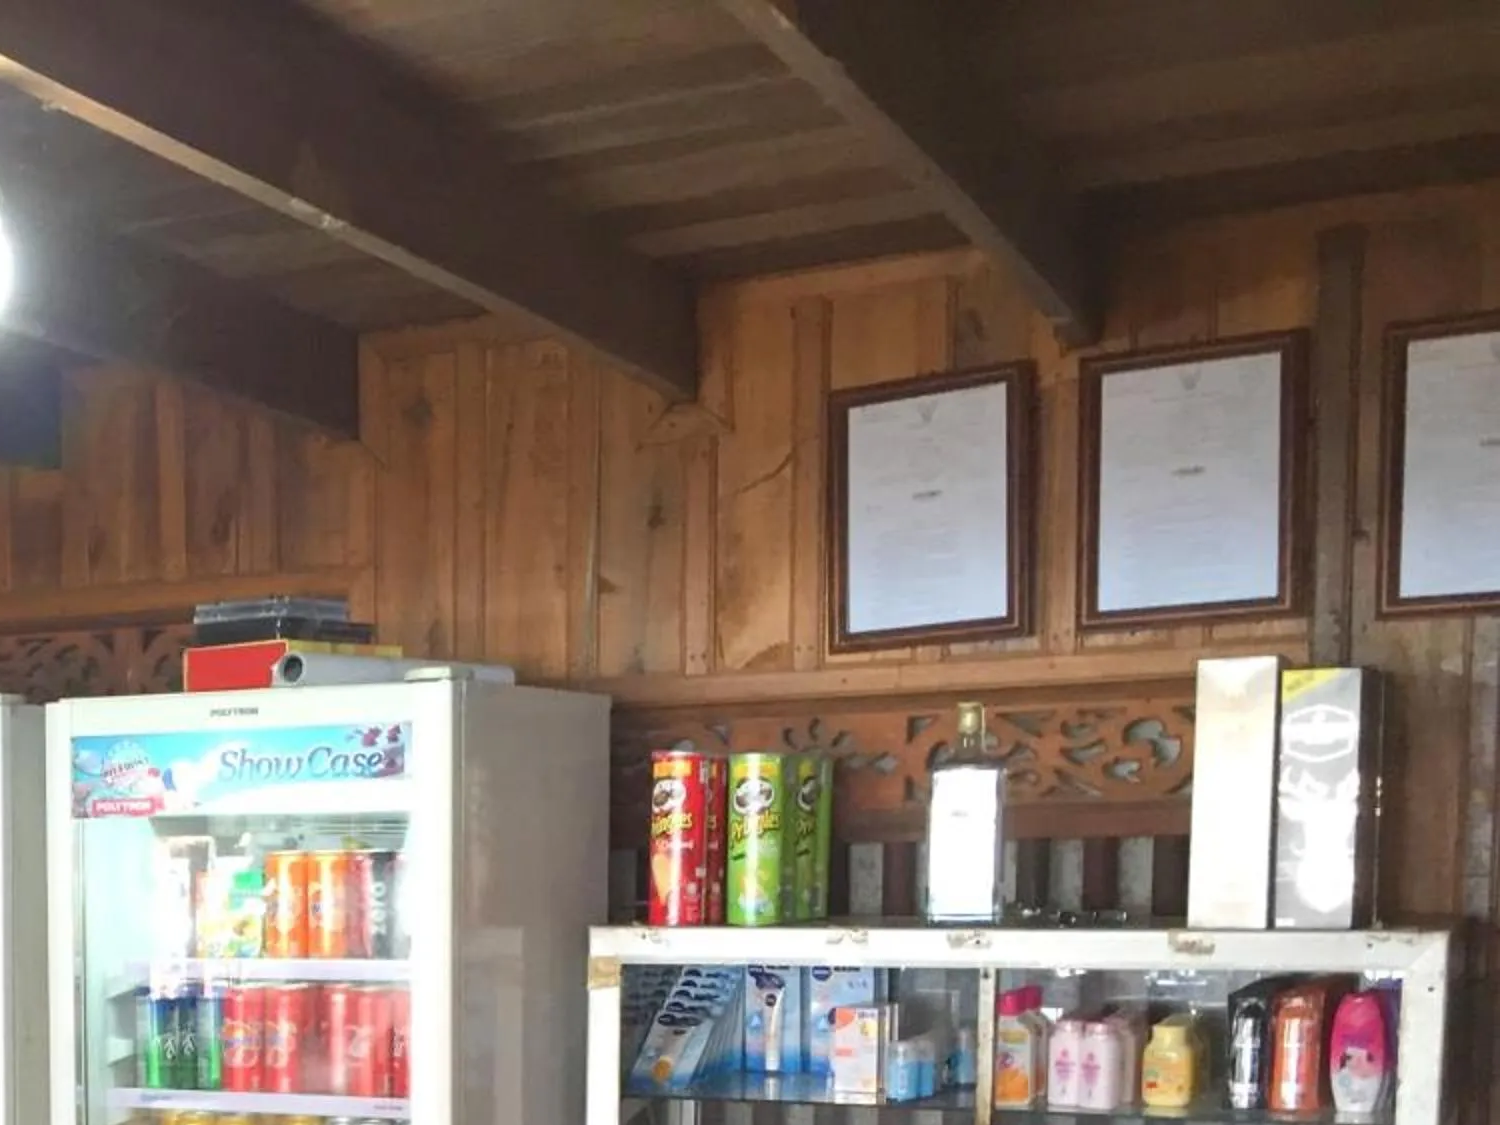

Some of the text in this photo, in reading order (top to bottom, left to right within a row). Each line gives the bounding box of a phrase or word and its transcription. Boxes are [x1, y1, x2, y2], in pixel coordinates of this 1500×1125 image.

[209, 706, 259, 717] POLYTRON
[219, 745, 383, 782] Show Case
